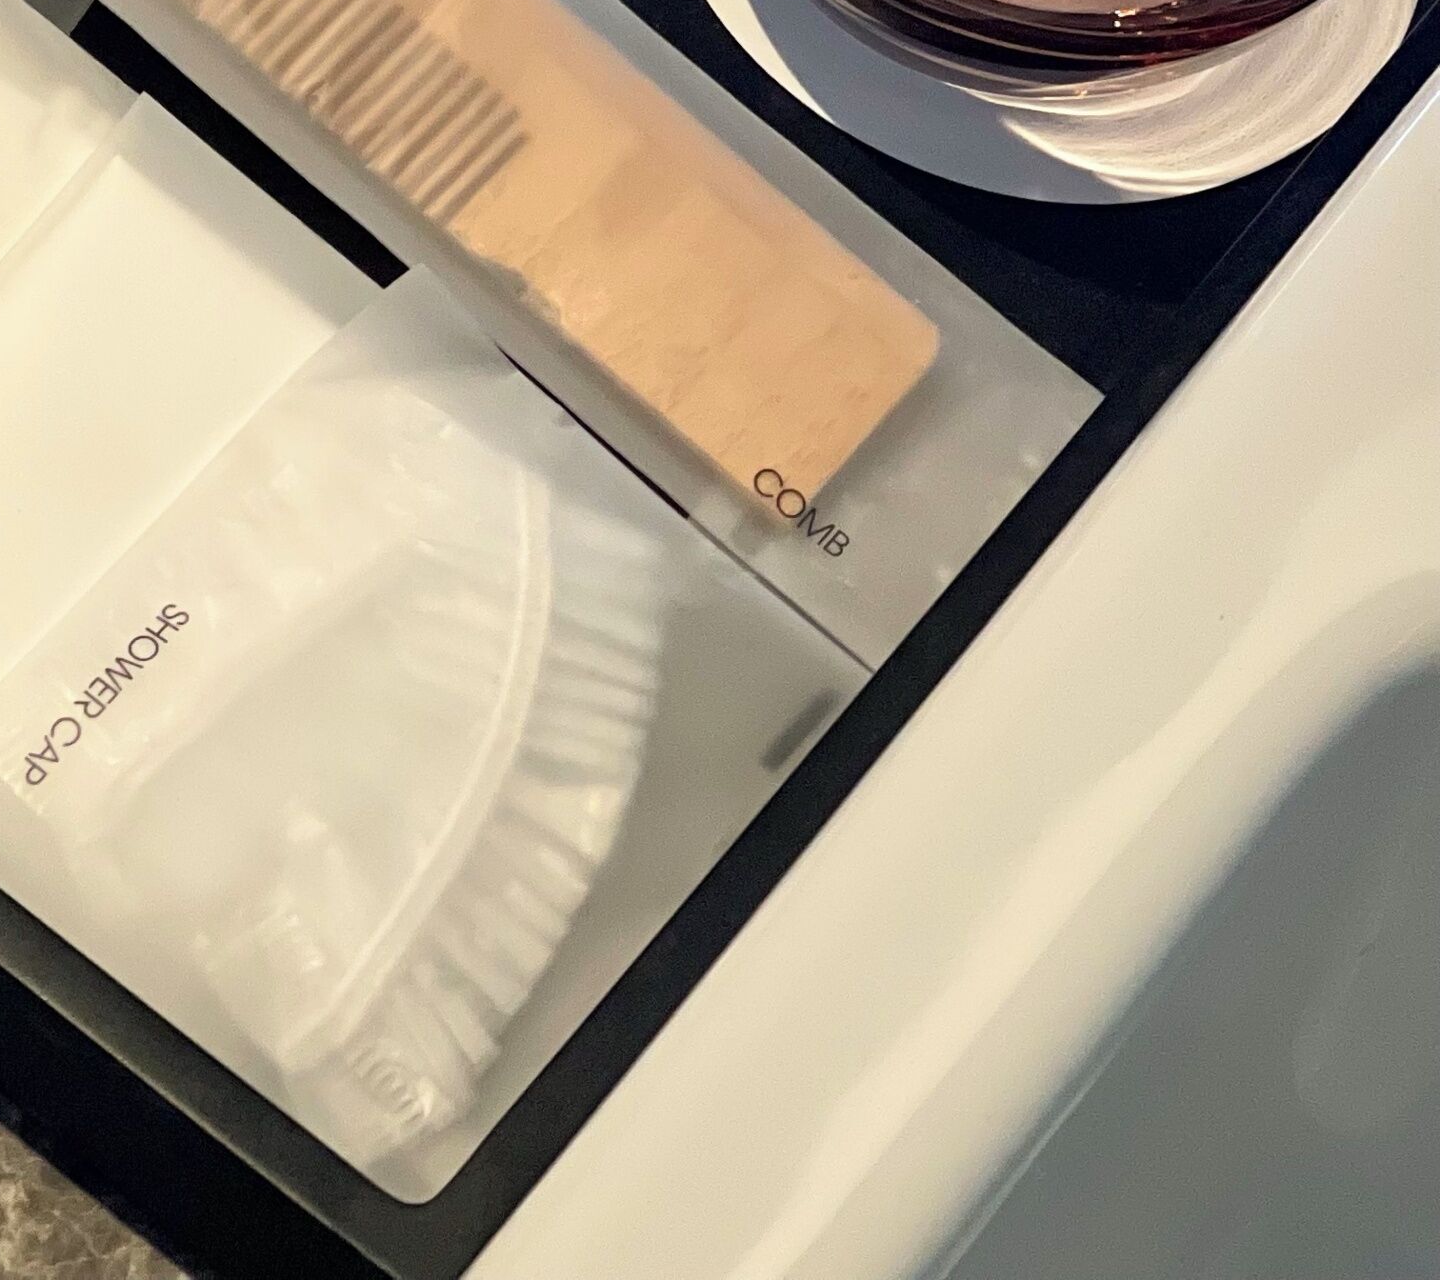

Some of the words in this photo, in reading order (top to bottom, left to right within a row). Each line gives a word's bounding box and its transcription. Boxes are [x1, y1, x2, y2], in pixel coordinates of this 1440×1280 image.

[752, 467, 851, 559] COMB
[74, 601, 191, 719] SHOWER
[23, 715, 82, 787] CAP
